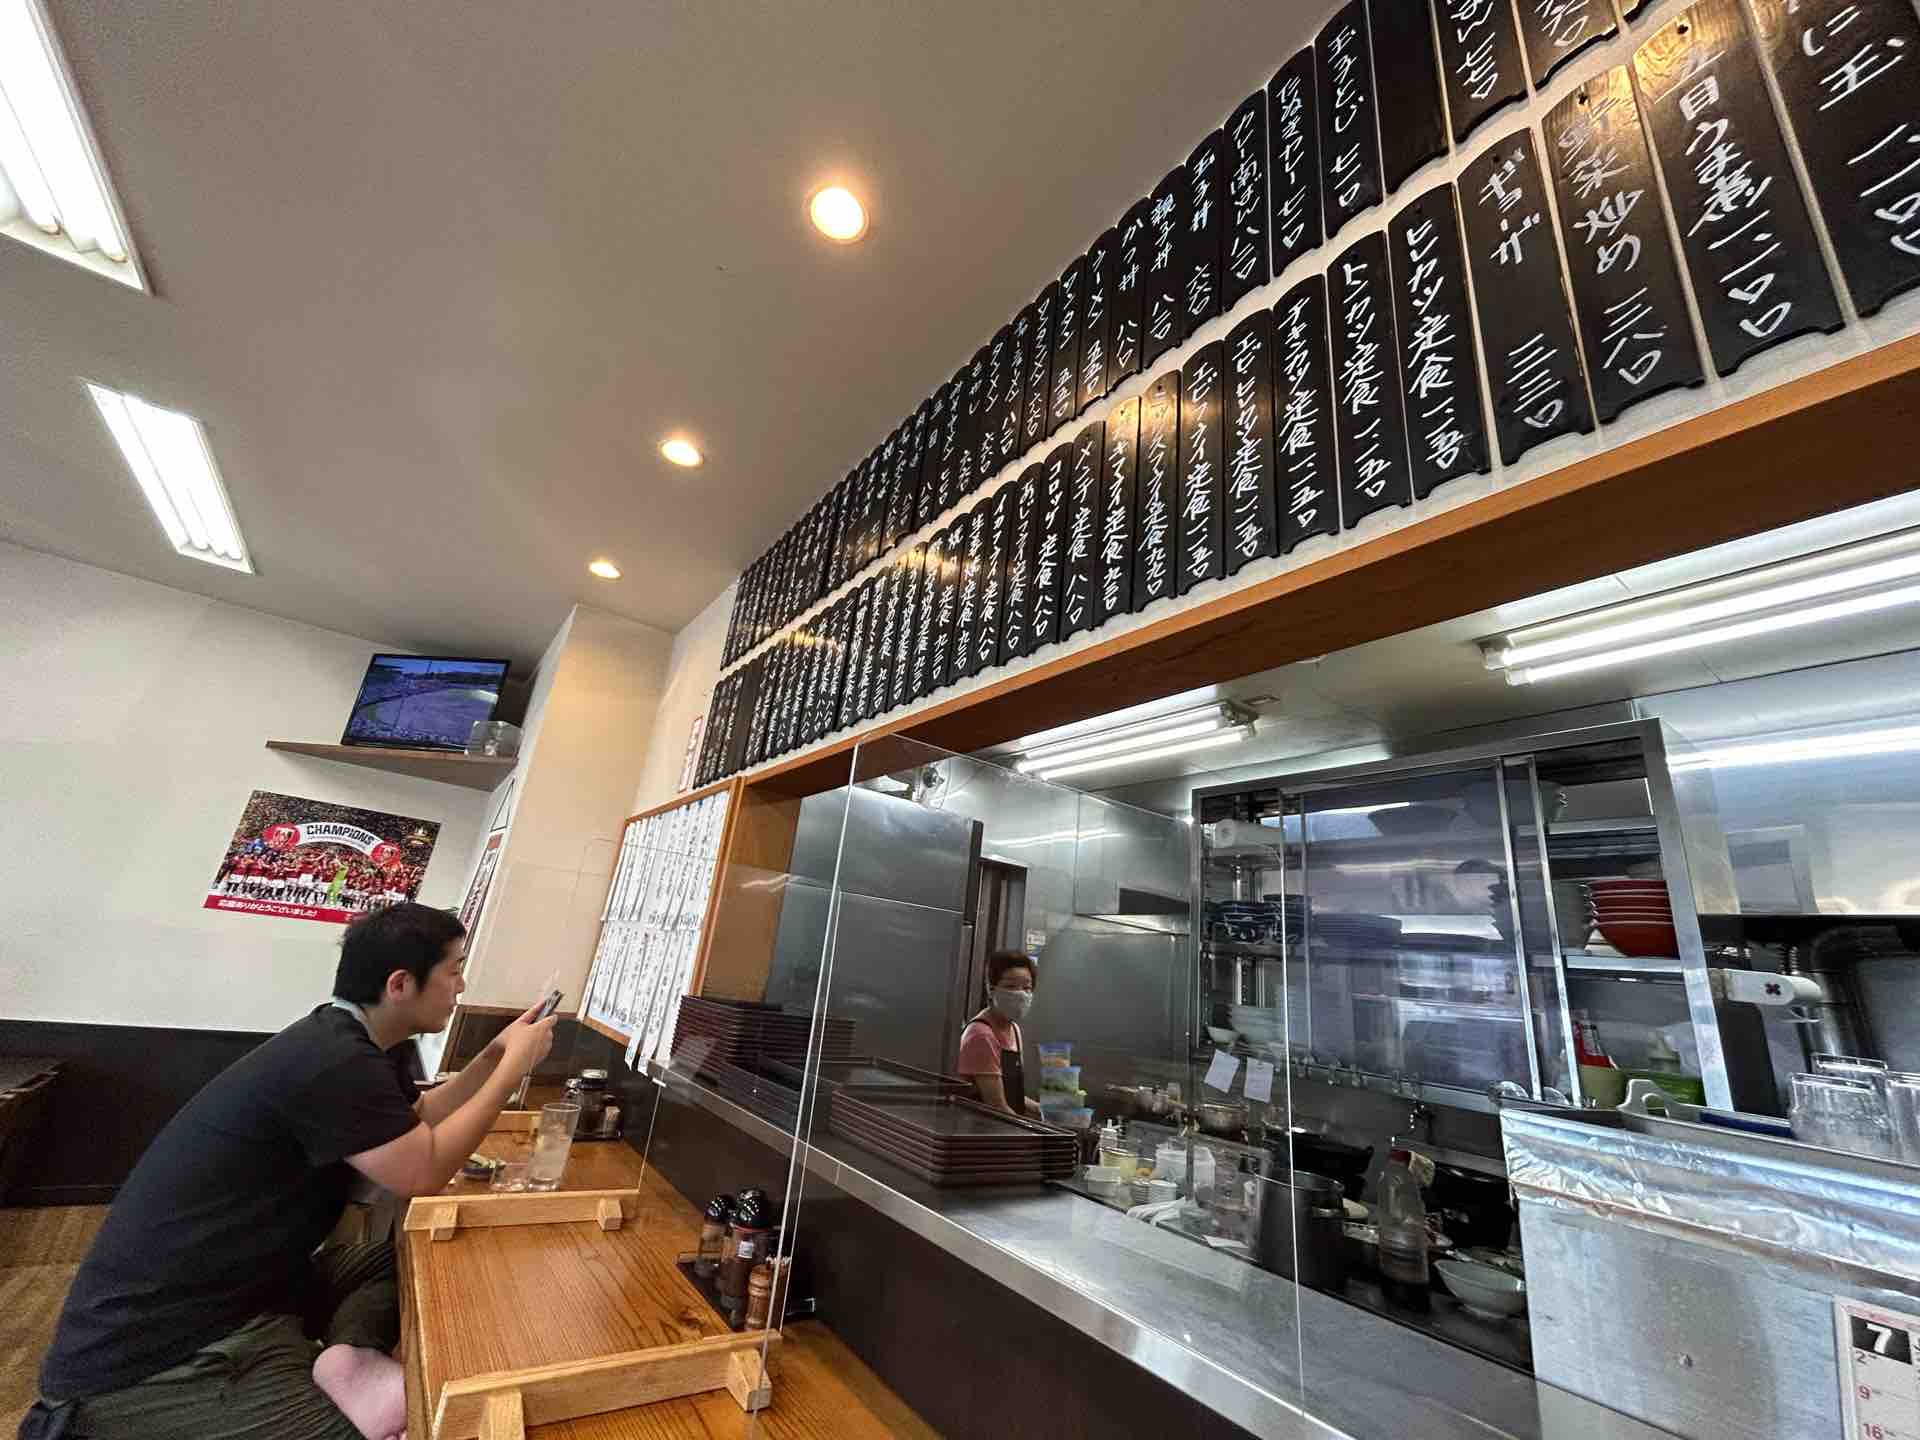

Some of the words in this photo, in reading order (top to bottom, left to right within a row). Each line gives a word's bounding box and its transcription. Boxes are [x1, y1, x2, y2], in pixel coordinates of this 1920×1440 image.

[1328, 26, 1364, 133] 玉子とじ
[1331, 143, 1360, 207] 七一〇
[1277, 186, 1306, 248] 七一〇
[1339, 264, 1384, 414] トンカツ定食
[1407, 219, 1455, 398] ヒレカツ定食
[1602, 288, 1667, 384] 三八〇
[1278, 297, 1318, 455] チキンカツ定食
[1506, 333, 1563, 428] 三三〇
[1104, 427, 1132, 564] キフライ定食
[306, 824, 375, 845] CHAMPIONS
[1856, 1350, 1867, 1365] 2
[1866, 1322, 1893, 1354] 7
[1859, 1384, 1870, 1400] 9
[1863, 1422, 1882, 1440] 16
